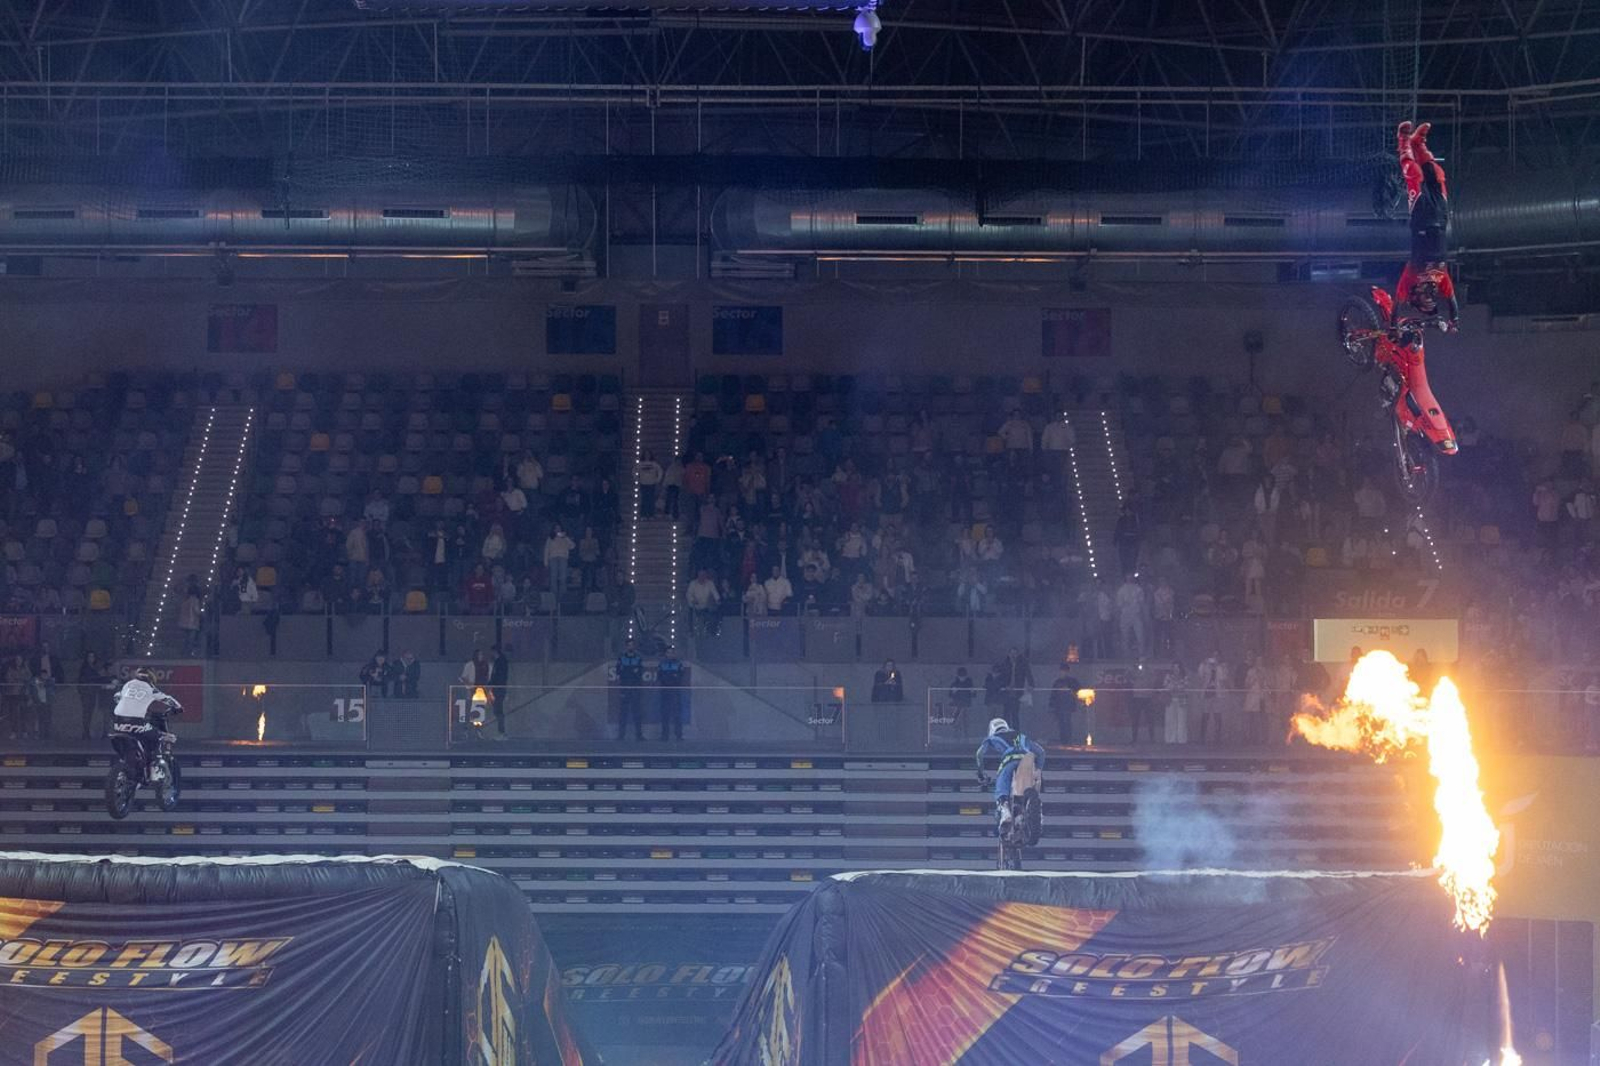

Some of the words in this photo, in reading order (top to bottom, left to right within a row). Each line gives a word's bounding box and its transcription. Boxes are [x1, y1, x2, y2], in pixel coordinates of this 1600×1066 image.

[713, 307, 758, 319] Sector
[1335, 591, 1405, 609] Salida
[1417, 580, 1440, 609] 7
[503, 618, 534, 628] Sector
[750, 619, 781, 628] Sector
[333, 698, 365, 723] 15
[455, 698, 487, 723] 15
[807, 716, 835, 725] Sector
[928, 716, 955, 725] Sector
[0, 938, 108, 968] OLO
[110, 937, 288, 968] FLOW
[1011, 949, 1165, 978] SOLO
[1168, 944, 1321, 977] FLOW
[9, 969, 273, 987] EESTYLE
[561, 964, 668, 985] SOLO
[989, 970, 1325, 997] FREESTYLE
